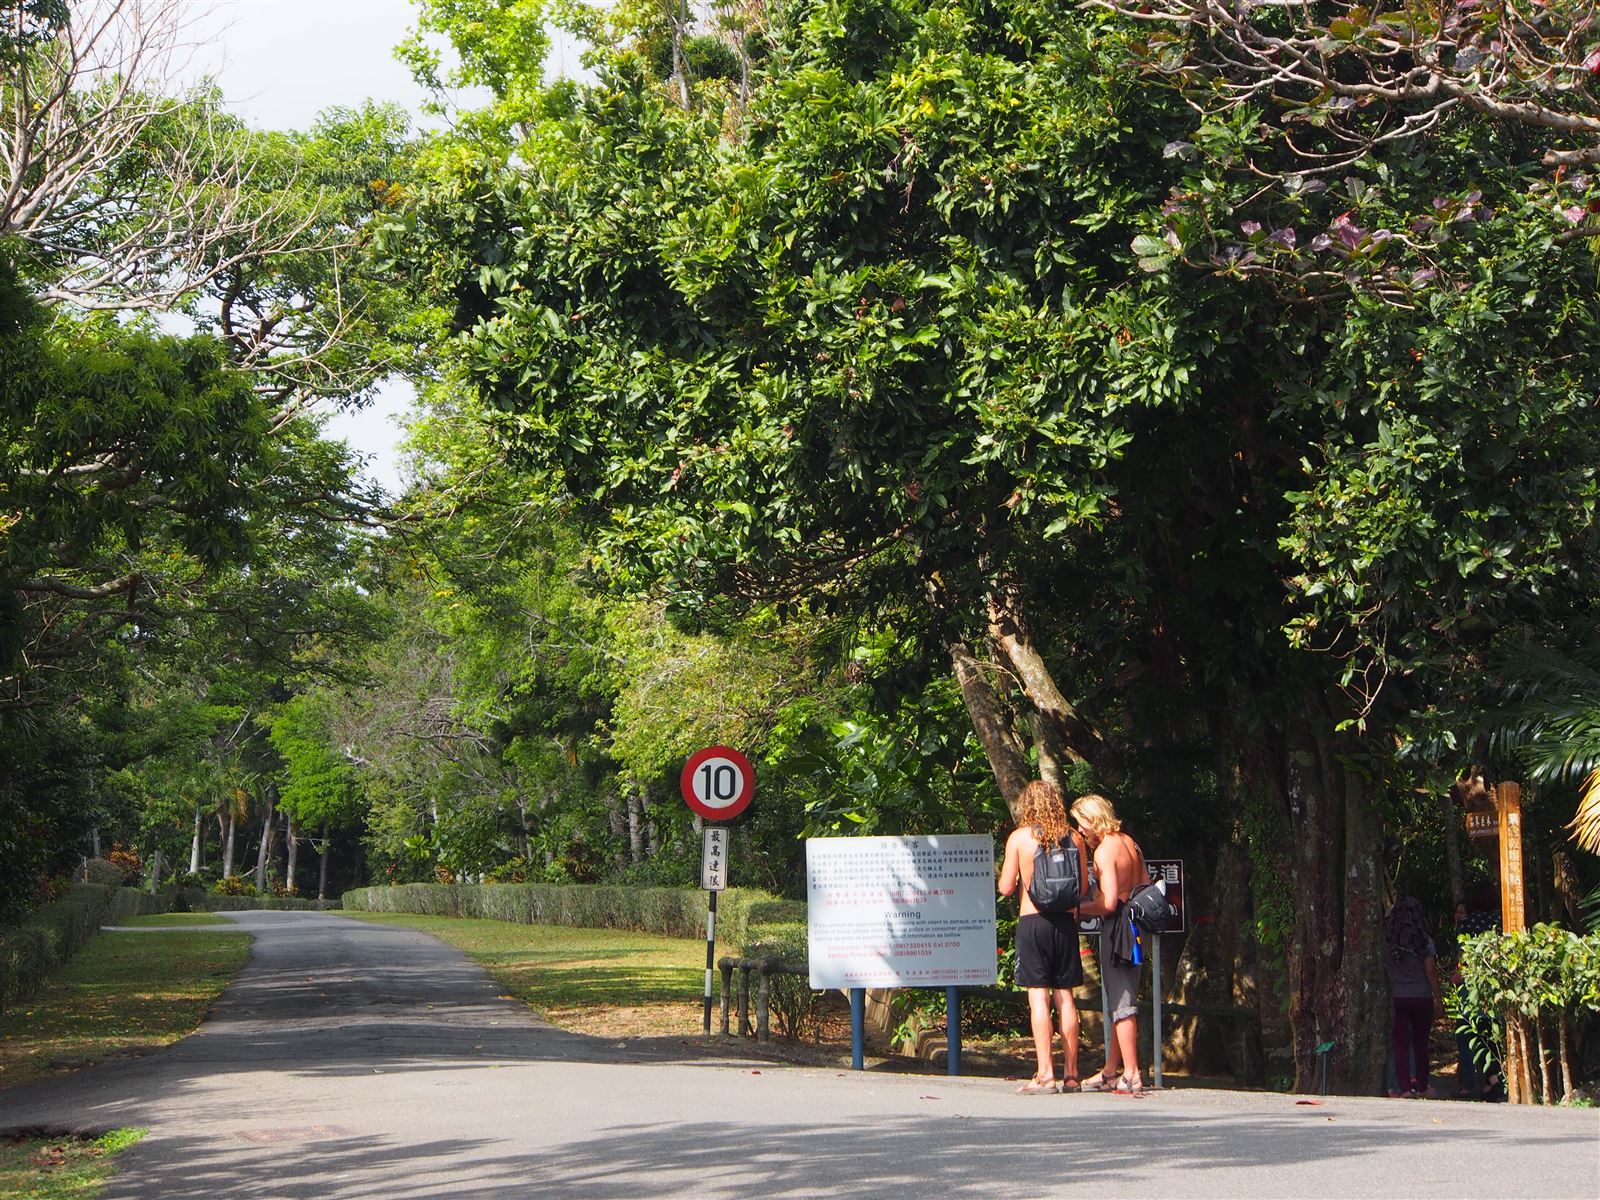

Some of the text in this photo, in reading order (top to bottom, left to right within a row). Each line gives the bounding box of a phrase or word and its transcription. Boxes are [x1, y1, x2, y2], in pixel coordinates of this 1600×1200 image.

[701, 765, 736, 800] 10
[709, 830, 721, 886] 最高速限
[884, 911, 921, 920] Warning
